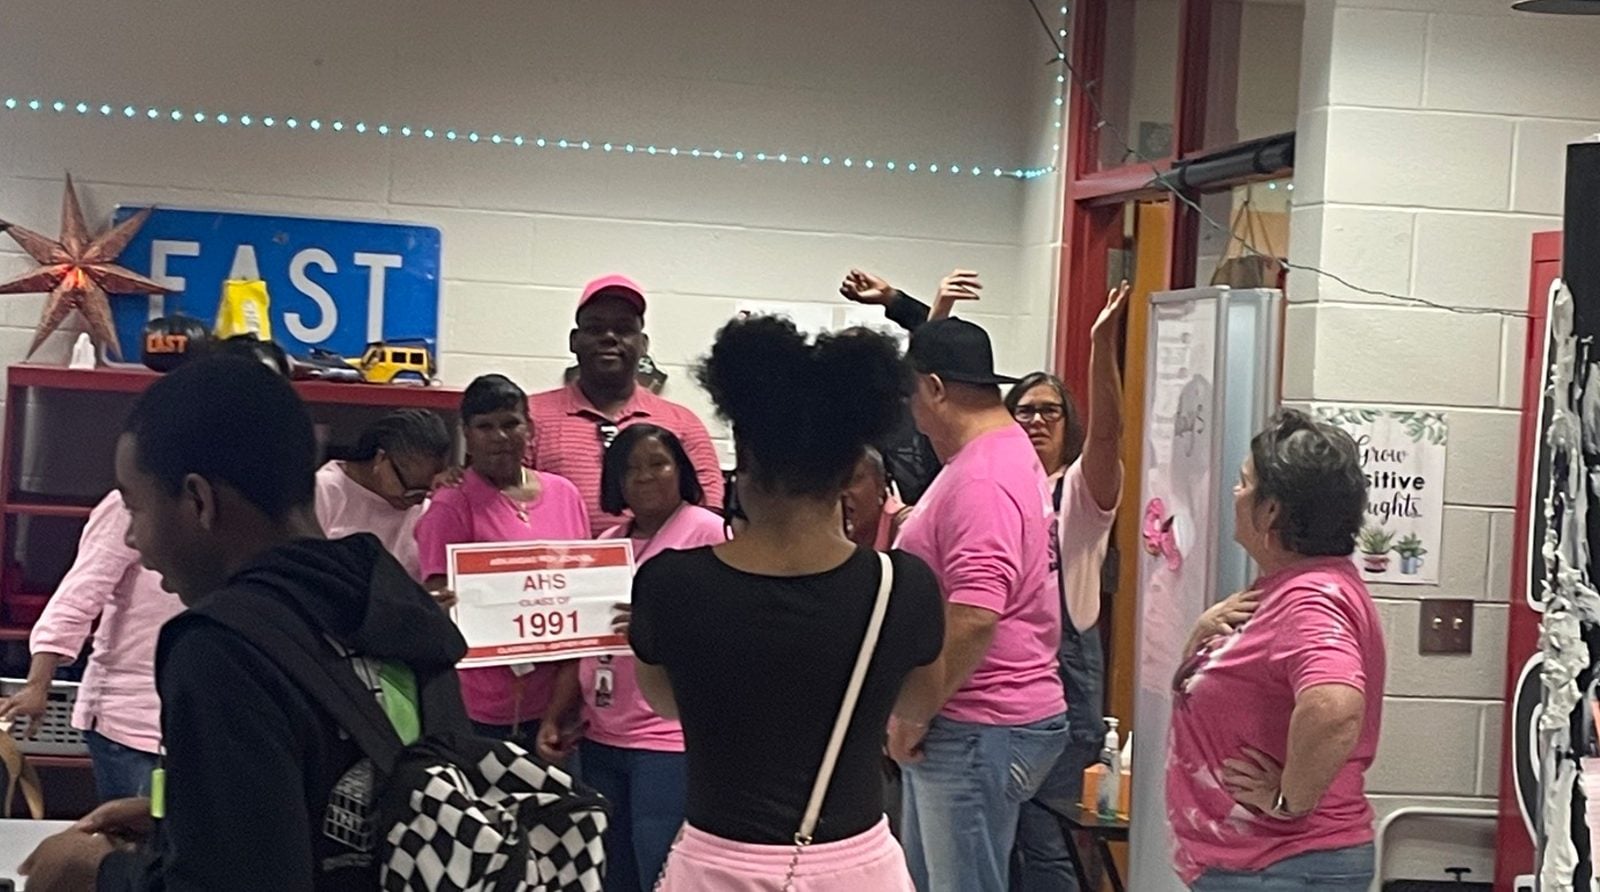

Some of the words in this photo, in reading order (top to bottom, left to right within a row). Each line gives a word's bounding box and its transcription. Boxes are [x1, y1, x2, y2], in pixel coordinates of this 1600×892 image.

[148, 333, 187, 352] EAST
[1364, 470, 1425, 490] sitive
[1367, 491, 1423, 525] ughts
[523, 573, 566, 591] AHS
[512, 610, 578, 638] 1991
